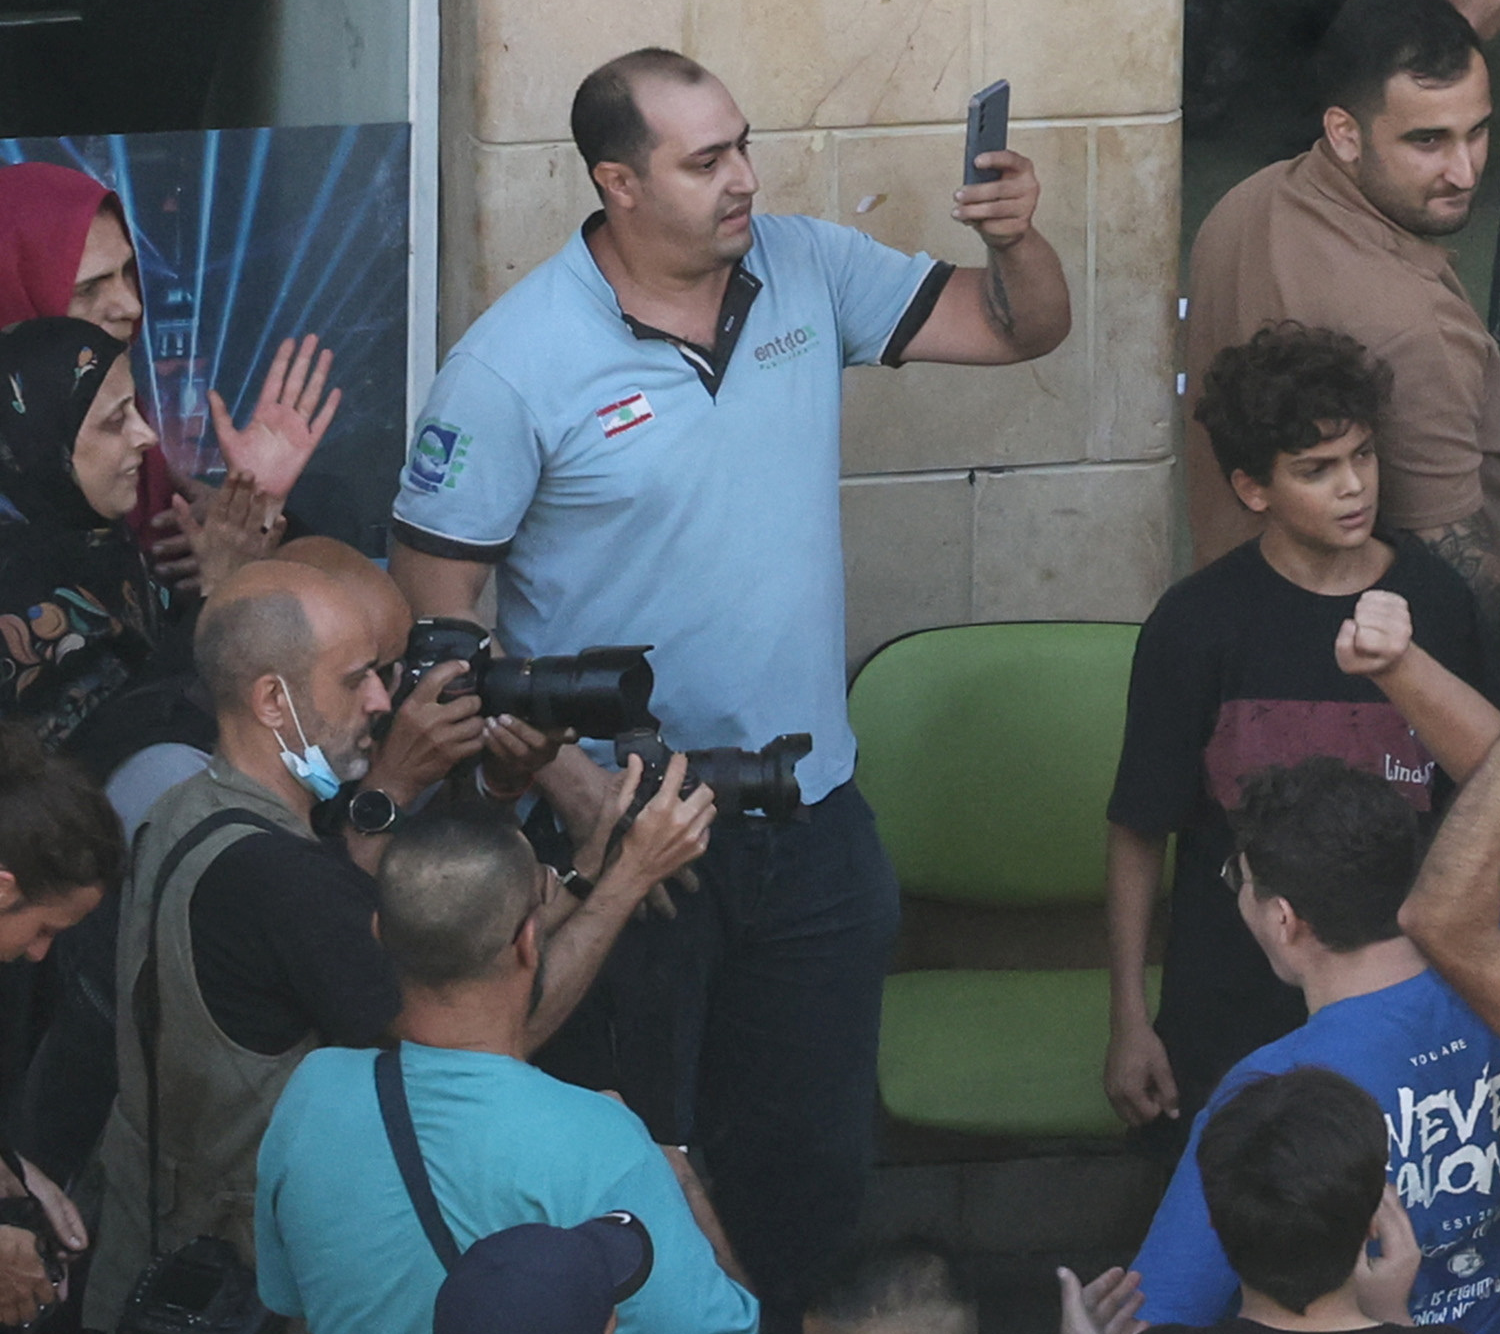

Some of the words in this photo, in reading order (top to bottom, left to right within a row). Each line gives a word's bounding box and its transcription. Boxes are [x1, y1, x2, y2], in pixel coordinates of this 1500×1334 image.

[1410, 1051, 1438, 1067] YOU
[1441, 1038, 1467, 1056] ARE
[1442, 1215, 1472, 1232] EST
